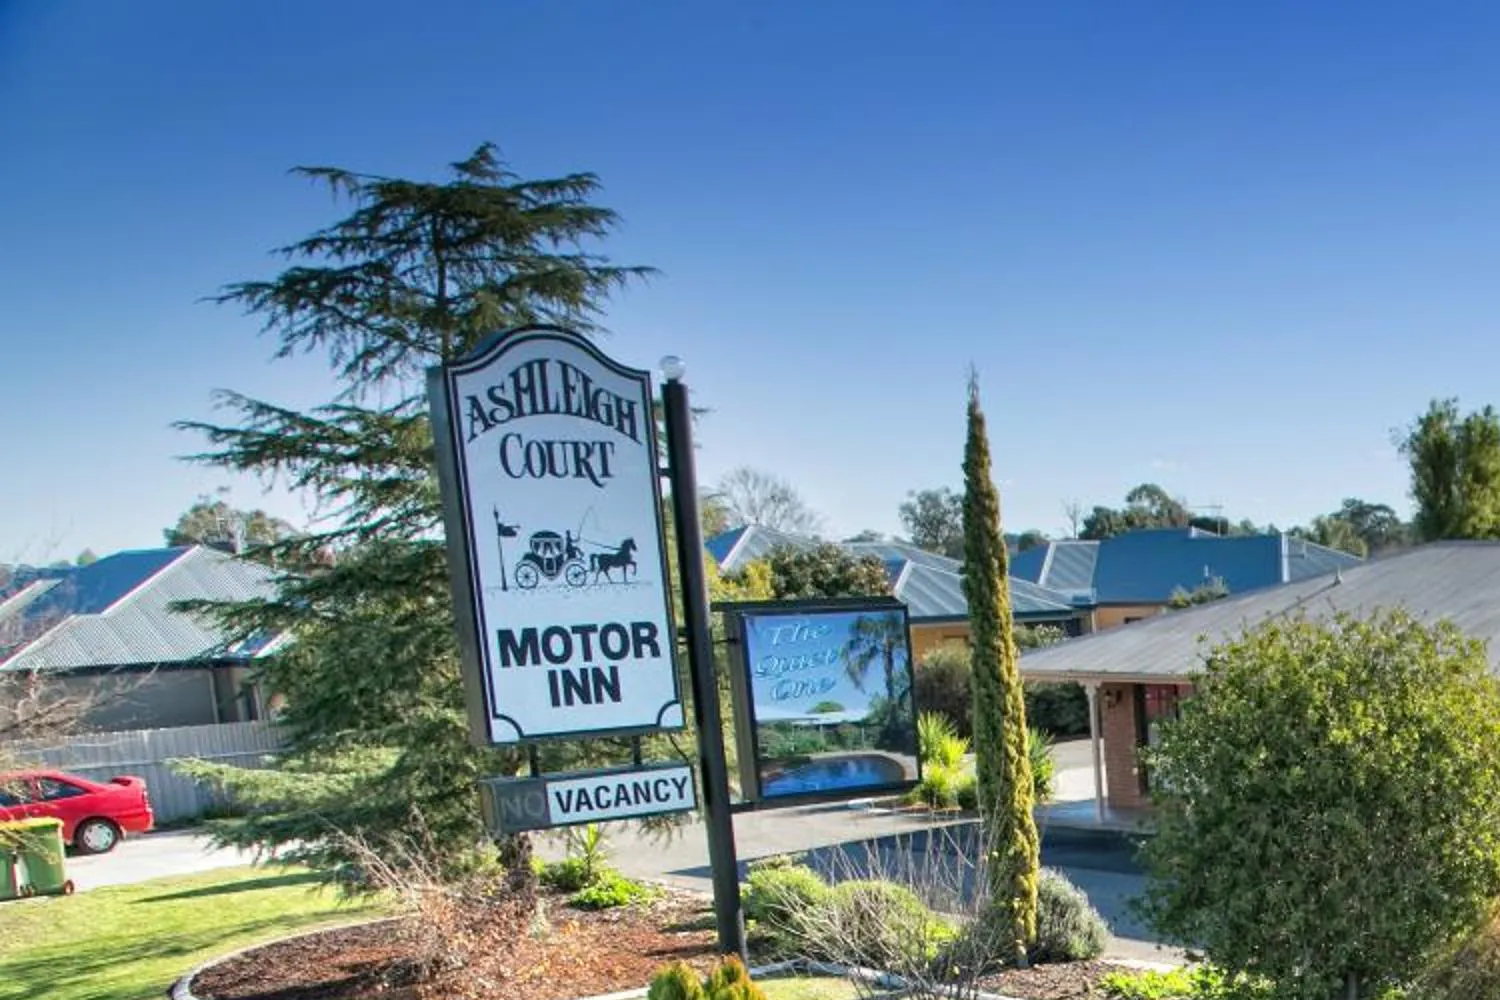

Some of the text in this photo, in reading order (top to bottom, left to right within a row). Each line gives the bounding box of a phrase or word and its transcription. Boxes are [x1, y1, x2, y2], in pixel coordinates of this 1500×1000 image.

[466, 358, 641, 444] ASHLEIGH
[500, 432, 615, 487] COURT
[497, 621, 661, 668] MOTOR
[548, 666, 622, 708] INN
[499, 775, 689, 820] NO VACANCY
